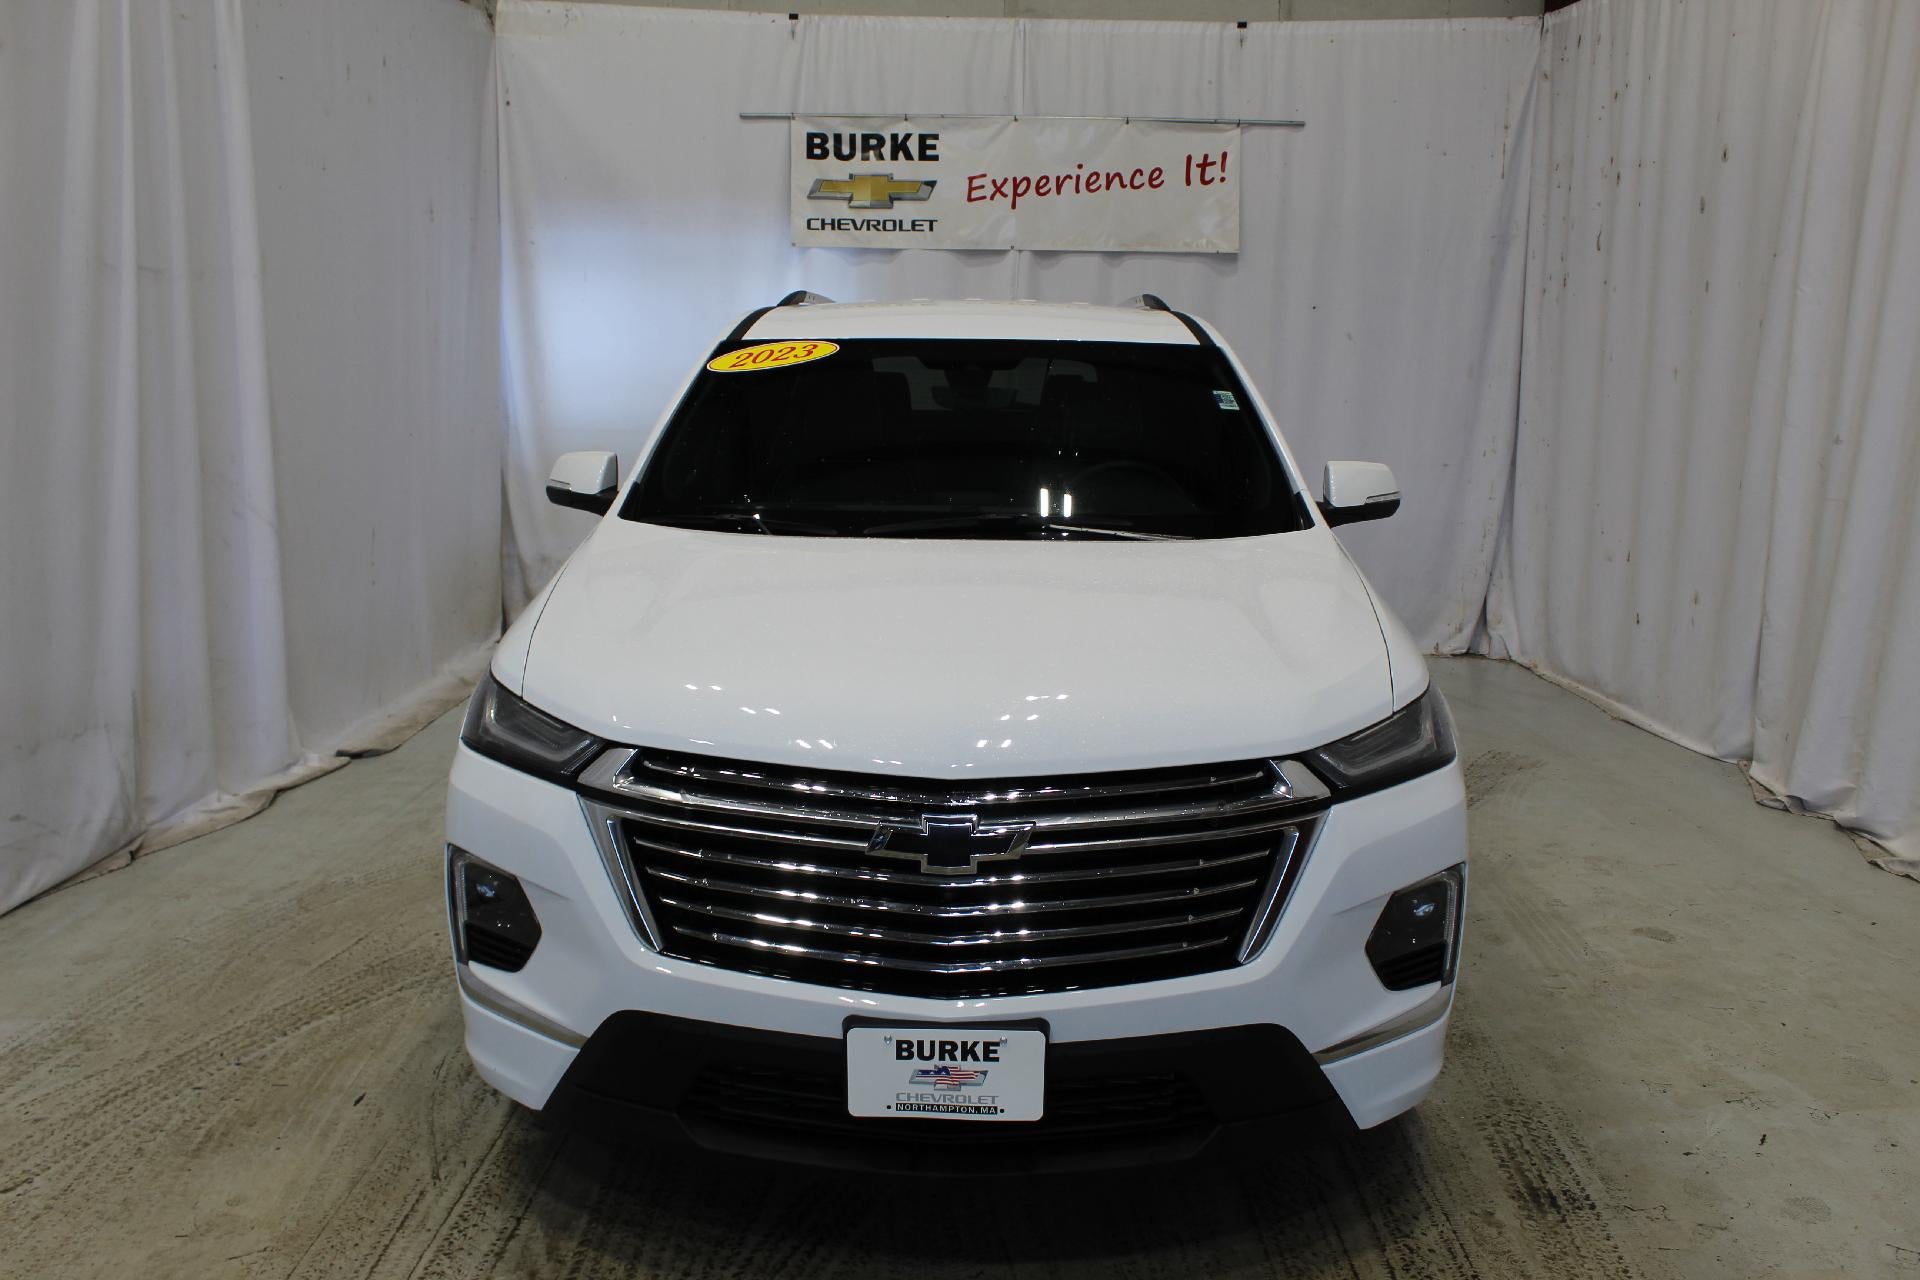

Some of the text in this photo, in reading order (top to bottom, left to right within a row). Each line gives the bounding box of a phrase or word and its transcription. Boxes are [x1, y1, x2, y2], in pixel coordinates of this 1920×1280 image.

[806, 132, 940, 161] BURKE
[966, 151, 1228, 209] Experience It!
[806, 218, 938, 232] CHEVROLET
[729, 343, 819, 369] 2023
[895, 1039, 1000, 1062] BURKE
[896, 1092, 999, 1105] CHEVROLET
[981, 1107, 996, 1115] MA
